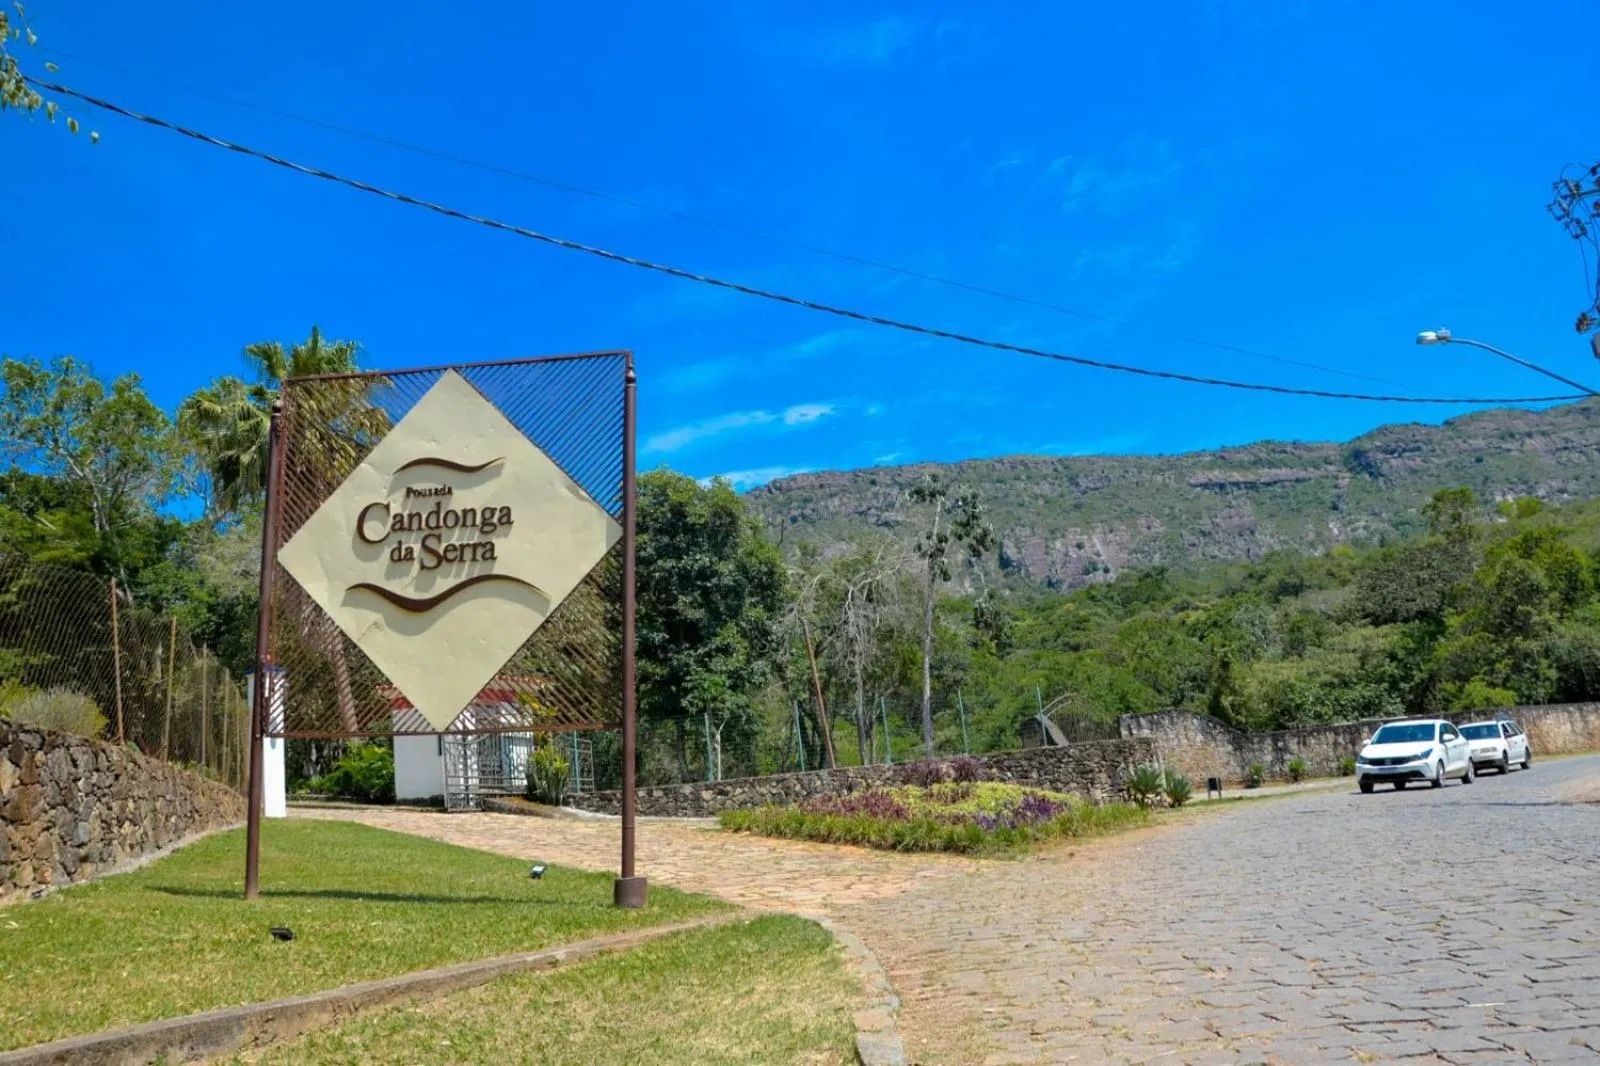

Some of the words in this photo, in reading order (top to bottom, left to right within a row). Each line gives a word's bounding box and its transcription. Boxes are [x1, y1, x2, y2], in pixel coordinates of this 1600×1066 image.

[406, 484, 453, 498] Pousada
[357, 501, 514, 544] Candonga
[390, 540, 416, 562] da
[420, 533, 497, 570] Serra
